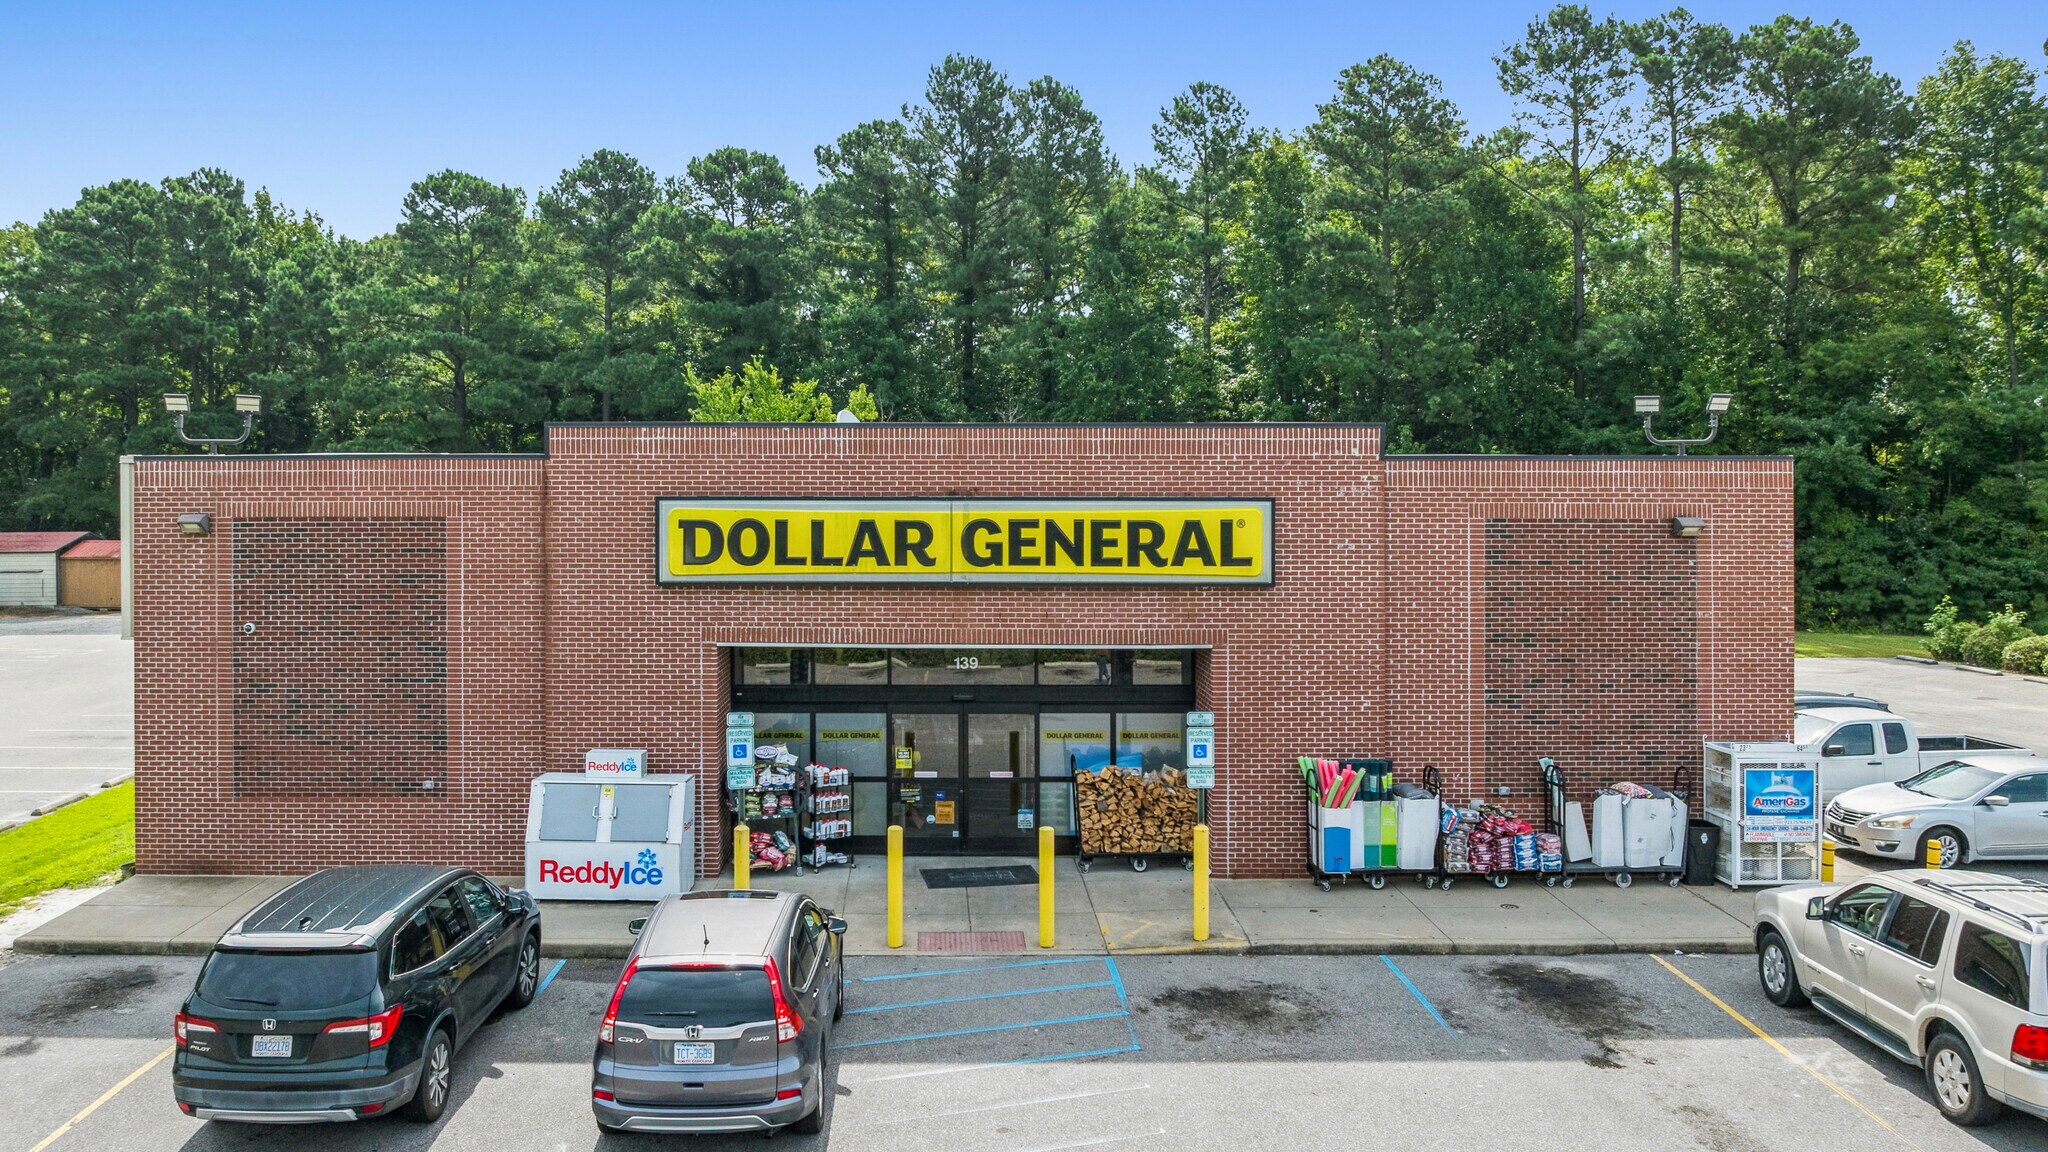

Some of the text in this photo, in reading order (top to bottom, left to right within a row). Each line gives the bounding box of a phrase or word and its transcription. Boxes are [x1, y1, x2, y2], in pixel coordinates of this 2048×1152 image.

[678, 517, 937, 567] DOLLAR
[954, 656, 979, 670] 139
[1753, 797, 1806, 806] AmeriGas
[539, 860, 663, 889] ReddyIce
[617, 1036, 644, 1044] CR-V
[748, 1035, 770, 1043] AWD
